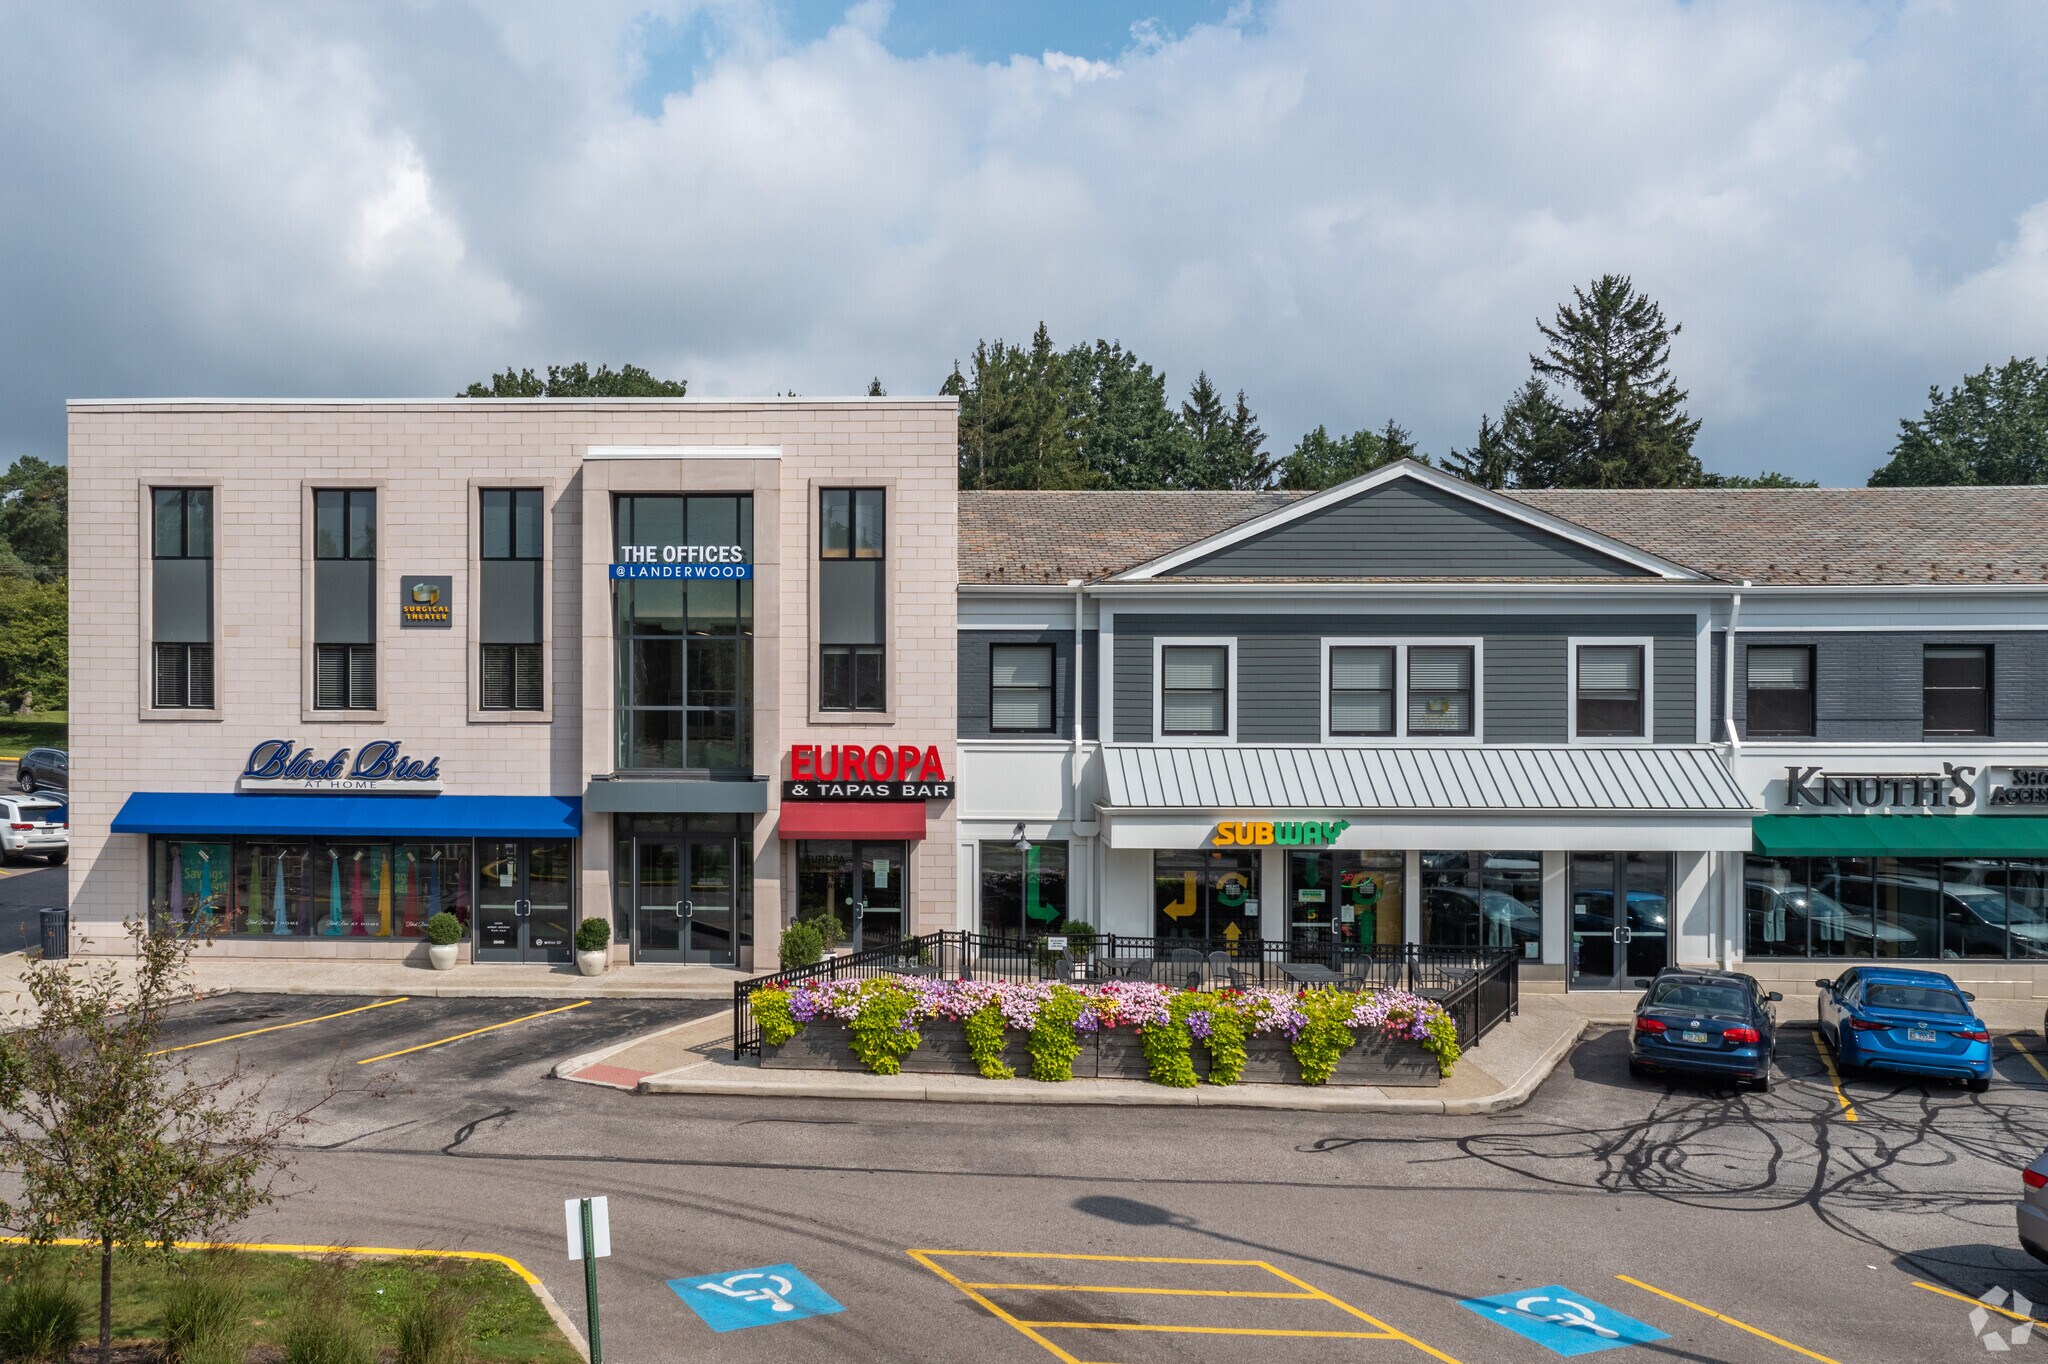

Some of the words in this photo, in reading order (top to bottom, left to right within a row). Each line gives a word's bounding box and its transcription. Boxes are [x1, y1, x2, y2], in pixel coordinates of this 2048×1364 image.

[621, 545, 658, 563] THE
[662, 545, 743, 563] OFFICES
[403, 605, 449, 613] SURGICAL
[244, 740, 351, 779] Block
[791, 744, 946, 781] EUROPA
[304, 780, 322, 788] AT
[330, 781, 377, 789] HOME
[791, 784, 809, 796] &
[817, 784, 890, 796] TAPAS
[902, 784, 949, 797] BAR
[1784, 761, 1976, 808] KNUTH'S
[1211, 819, 1351, 847] SUBWAY
